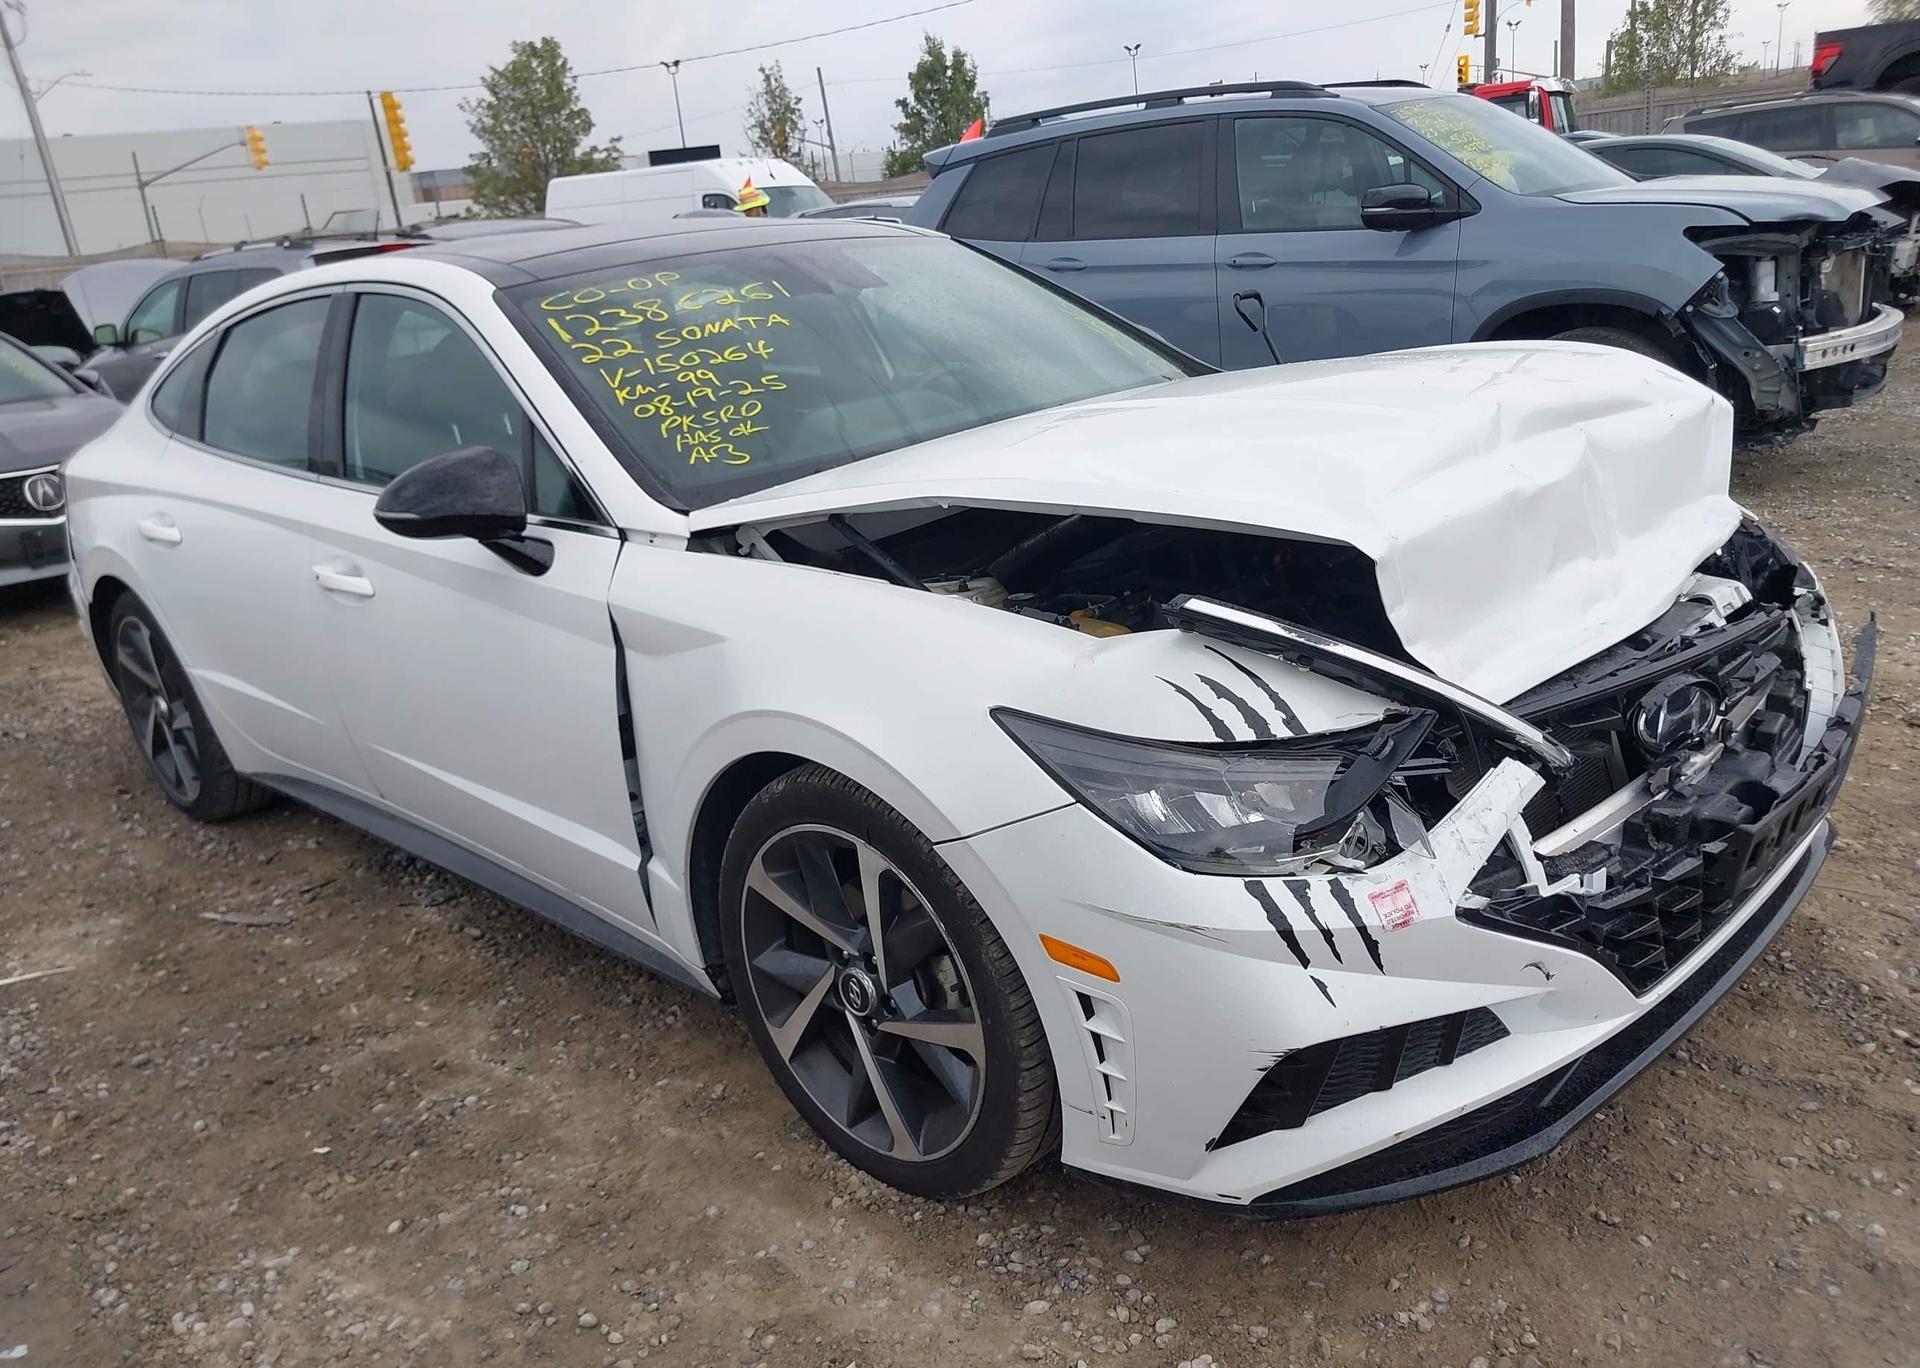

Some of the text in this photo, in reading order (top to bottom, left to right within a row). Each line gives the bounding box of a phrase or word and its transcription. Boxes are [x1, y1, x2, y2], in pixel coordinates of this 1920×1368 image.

[540, 271, 681, 311] CO-OP
[570, 313, 791, 364] 22 SONATA
[633, 374, 788, 419] 08-19-25
[1383, 907, 1403, 919] POLICE
[1387, 909, 1415, 925] REPORTED
[1392, 917, 1414, 929] DAMAGE
